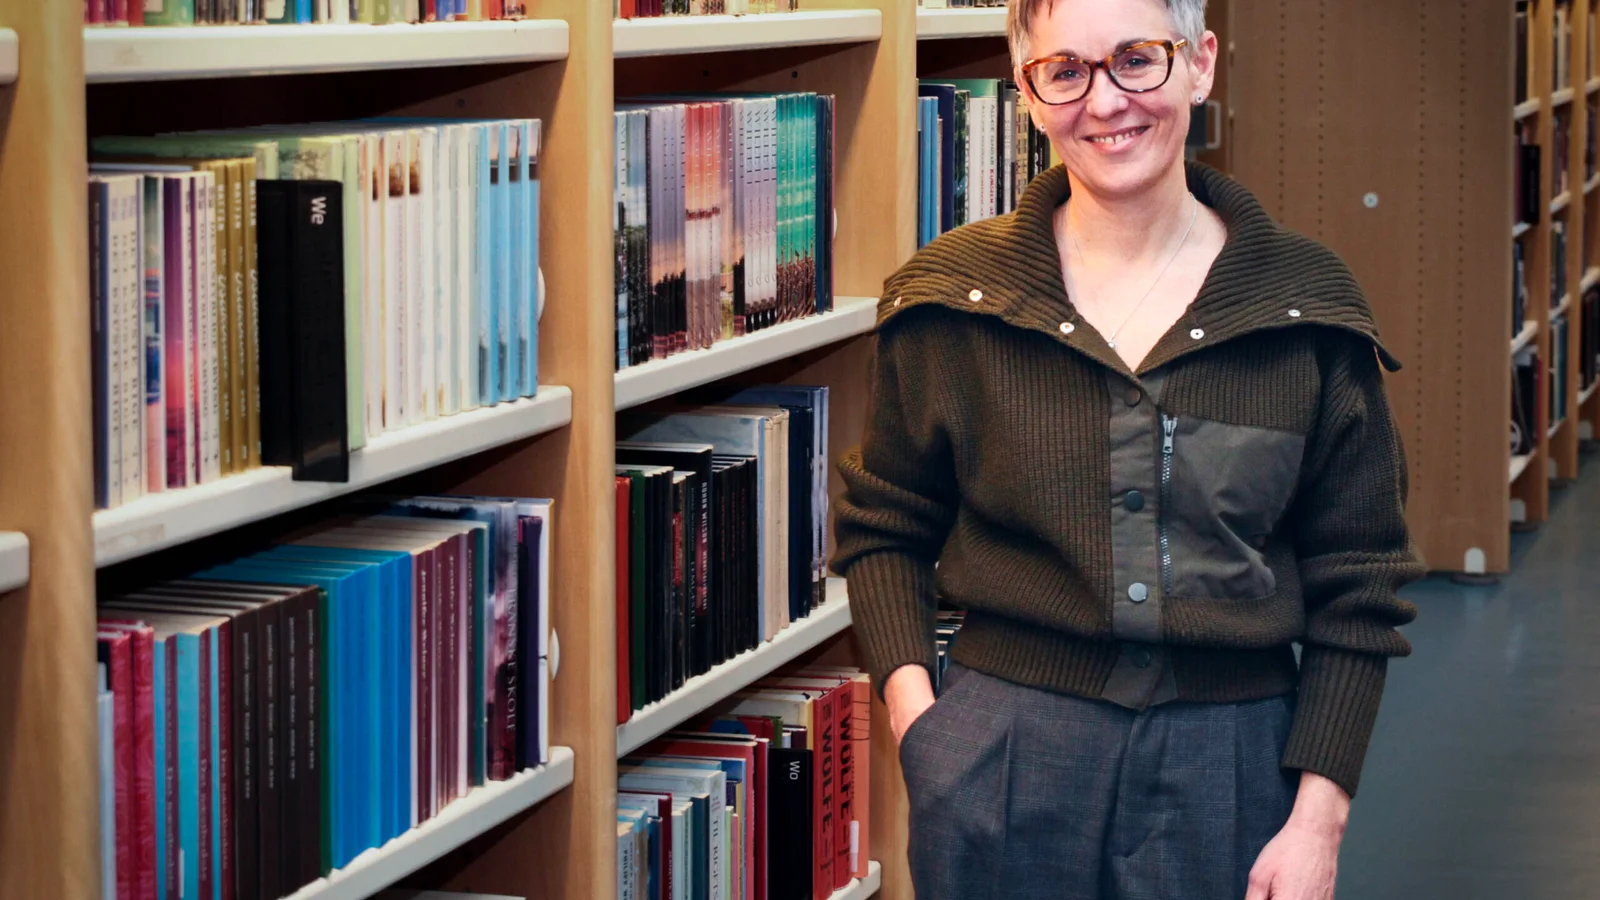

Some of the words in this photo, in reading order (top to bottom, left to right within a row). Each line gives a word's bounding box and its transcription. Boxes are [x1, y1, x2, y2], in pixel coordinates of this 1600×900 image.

[310, 196, 328, 225] We
[789, 760, 800, 780] Wo
[822, 723, 833, 833] WOLFE
[840, 711, 852, 820] WOLFE
